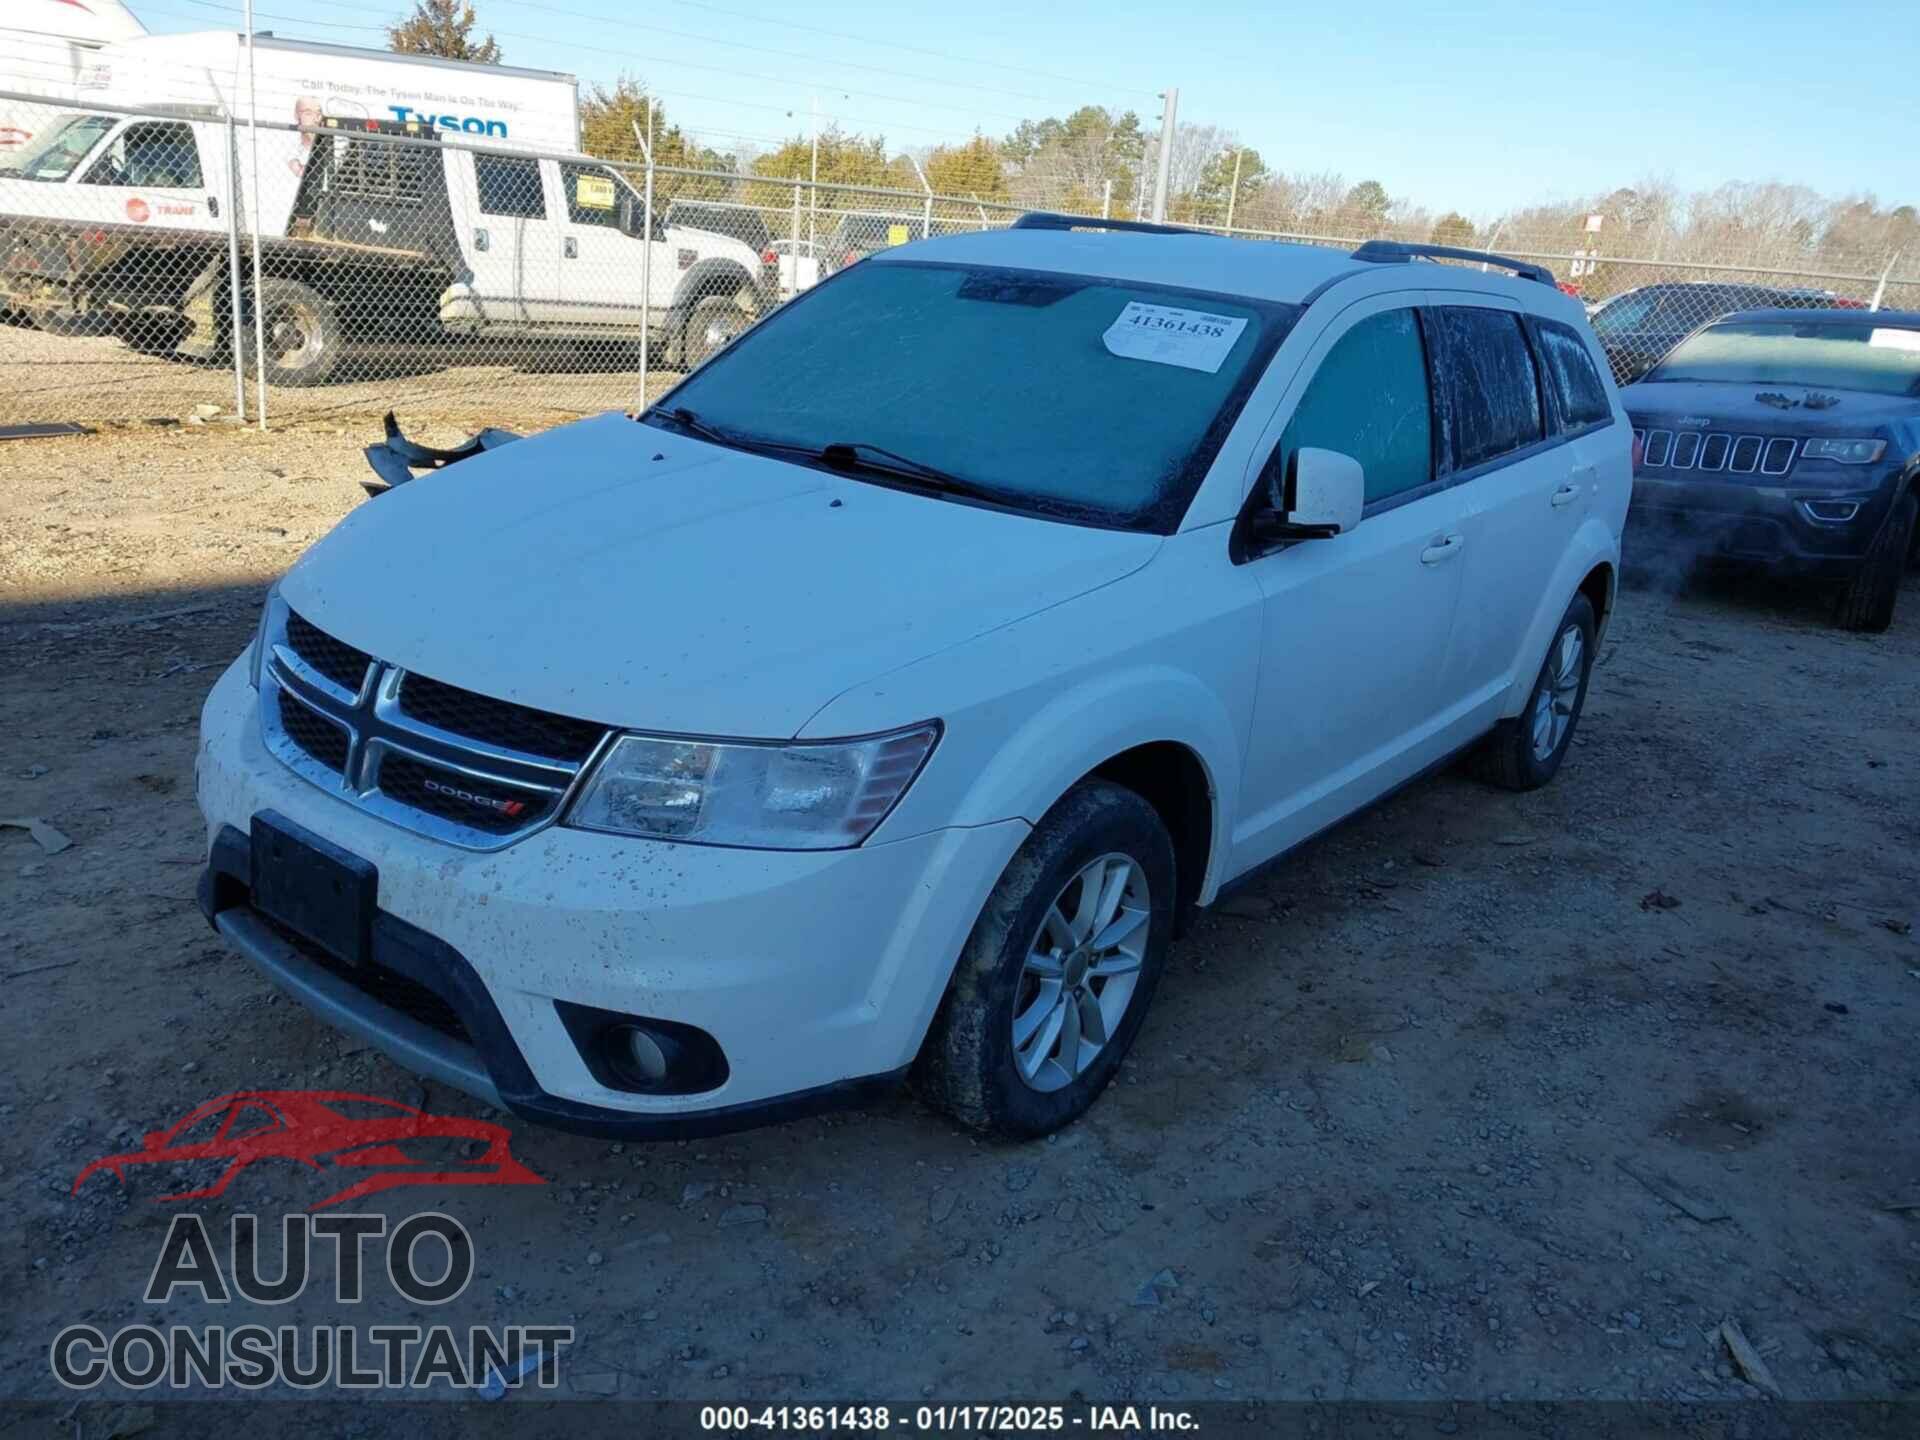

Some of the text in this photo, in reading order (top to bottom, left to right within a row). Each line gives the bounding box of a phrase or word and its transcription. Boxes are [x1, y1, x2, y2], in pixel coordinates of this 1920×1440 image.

[1129, 314, 1225, 338] 41361438
[1677, 415, 1711, 428] Jeep
[424, 780, 508, 811] DODGE
